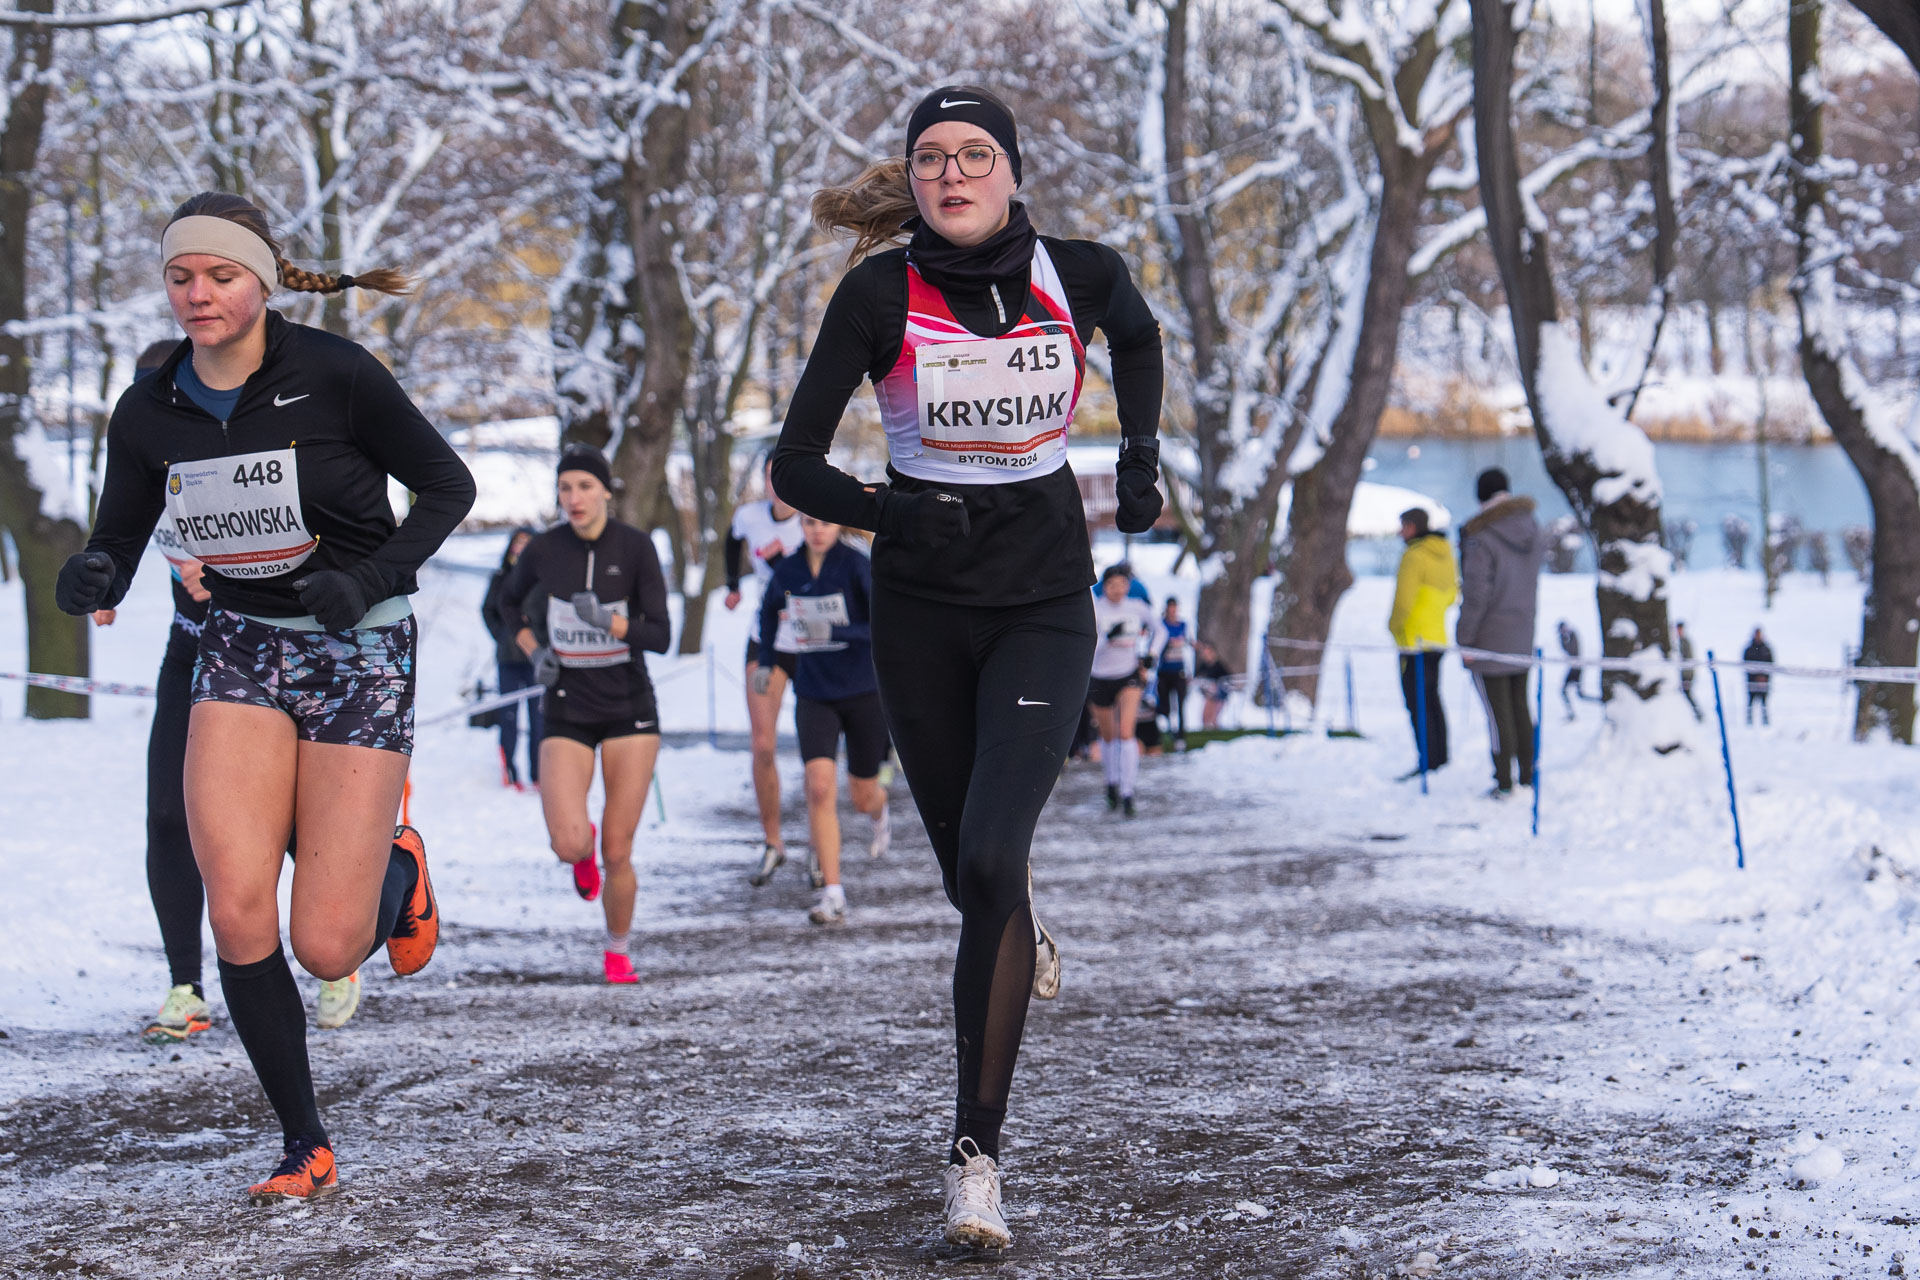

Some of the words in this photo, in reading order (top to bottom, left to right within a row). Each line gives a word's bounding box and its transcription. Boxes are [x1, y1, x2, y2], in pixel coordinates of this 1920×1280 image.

[1007, 343, 1061, 373] 415
[927, 390, 1068, 427] KRYSIAK
[233, 459, 283, 488] 448
[958, 454, 1008, 467] BYTOM
[1010, 452, 1038, 468] 2024
[175, 505, 301, 543] PIECHOWSKA
[221, 567, 260, 576] BYTOM
[260, 562, 291, 575] 2024
